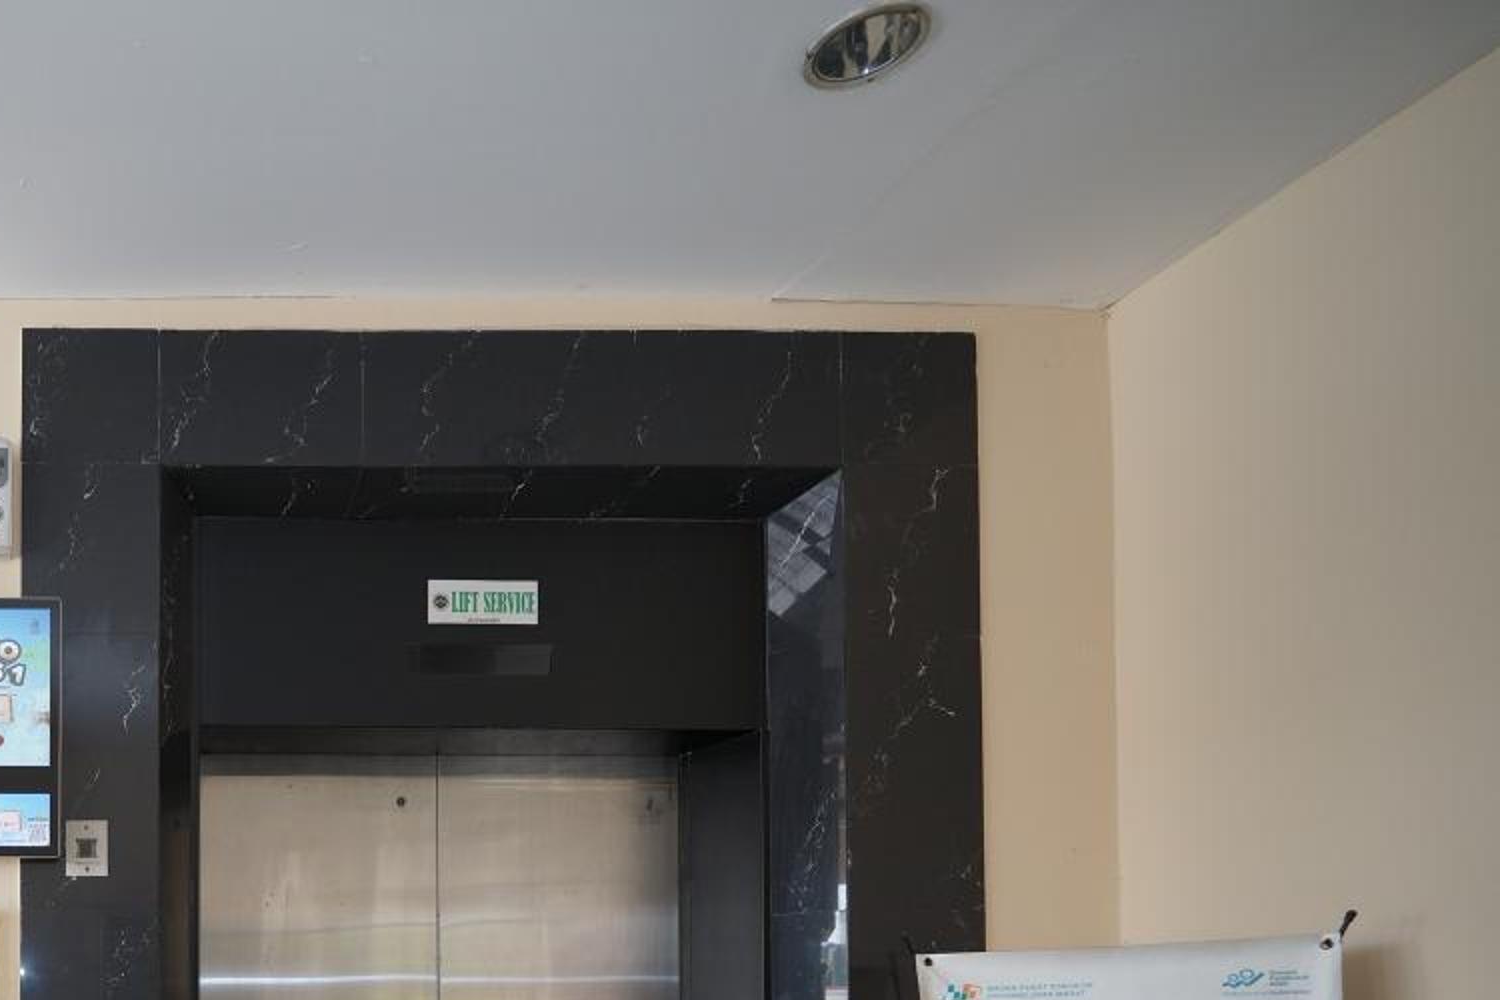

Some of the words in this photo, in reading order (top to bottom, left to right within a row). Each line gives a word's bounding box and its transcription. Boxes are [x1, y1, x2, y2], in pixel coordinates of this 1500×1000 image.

[451, 591, 479, 613] LIFT
[483, 591, 536, 614] SERVICE
[6, 663, 26, 686] 1
